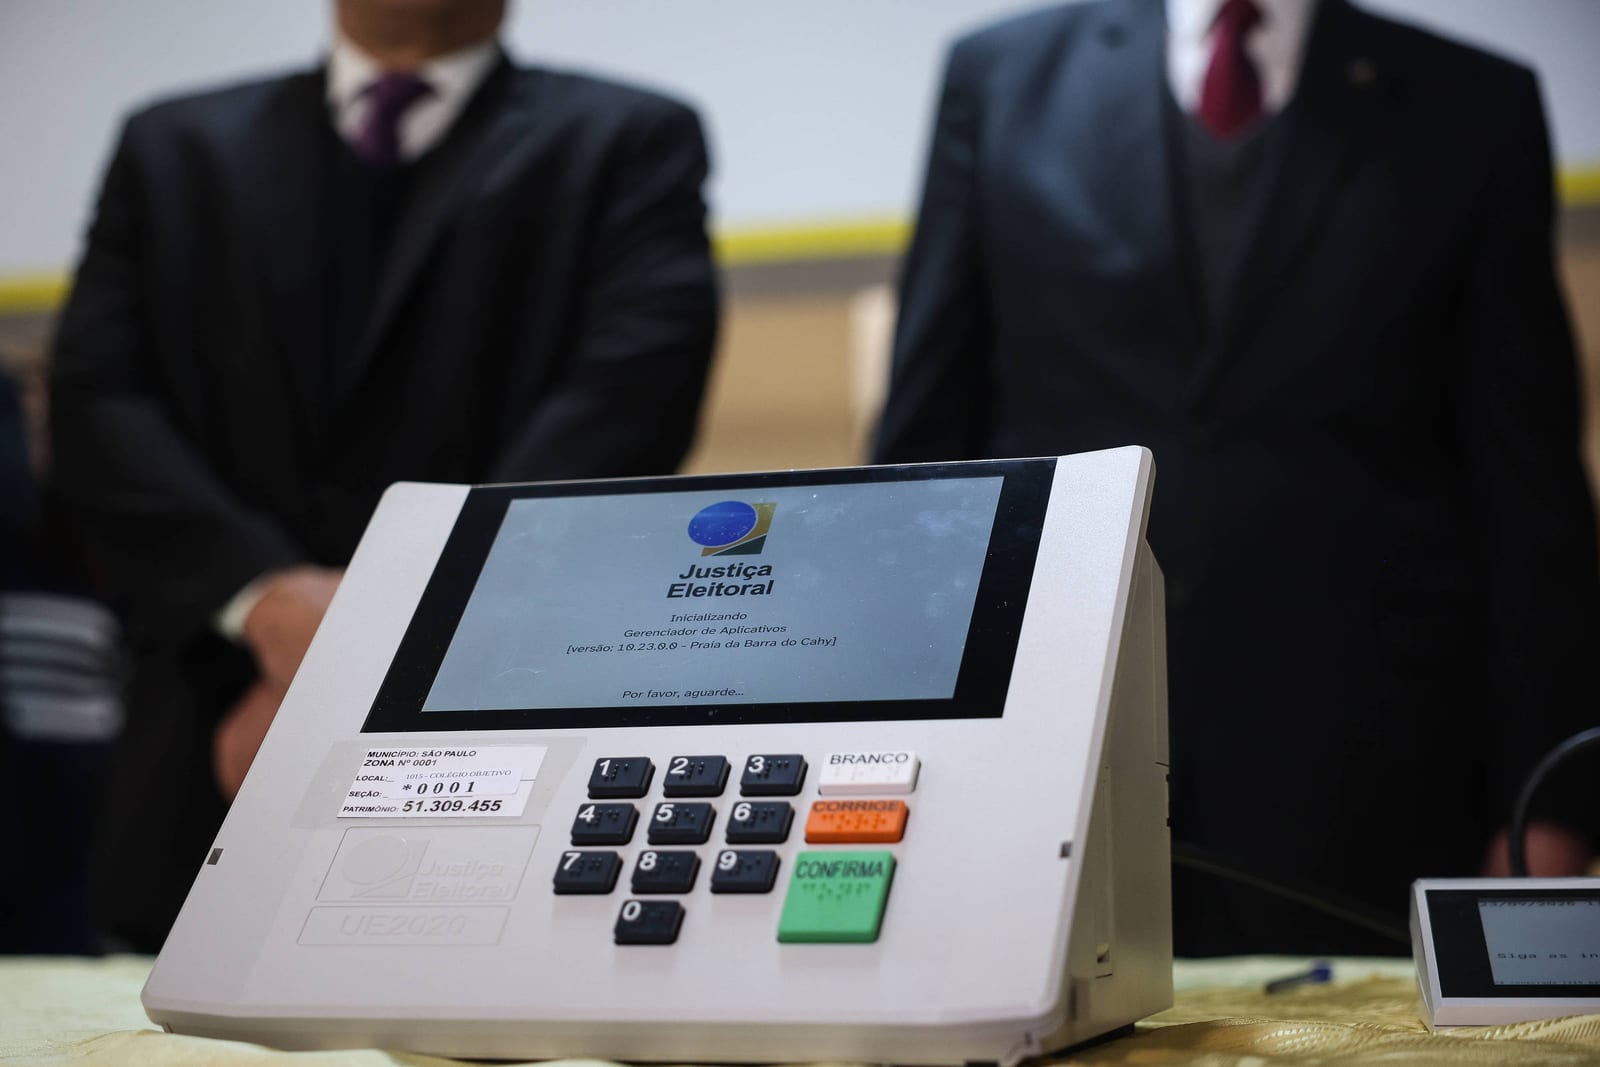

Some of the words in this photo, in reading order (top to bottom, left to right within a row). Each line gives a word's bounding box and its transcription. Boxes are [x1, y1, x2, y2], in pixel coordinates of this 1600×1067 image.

[679, 563, 773, 581] Justiça
[666, 580, 774, 598] Eleitoral
[670, 612, 748, 623] Inicializando
[623, 629, 699, 638] Gerenciador
[701, 628, 716, 636] de
[720, 625, 787, 636] Aplicativos
[566, 645, 614, 655] [versão:
[617, 642, 678, 652] 10.23.0.0
[690, 641, 721, 650] Praia
[725, 641, 740, 649] da
[744, 639, 777, 648] Barra
[781, 638, 797, 647] do
[800, 636, 837, 648] Cahy]
[622, 690, 643, 699] Por
[647, 689, 680, 699] favor,
[684, 688, 745, 699] aguarde...
[366, 750, 420, 758] MUNICÍPIO:
[421, 749, 442, 758] SÃO
[829, 754, 908, 765] BRANCO
[364, 759, 394, 767] ZONA
[412, 759, 437, 767] 0001
[600, 760, 611, 776] 1
[670, 757, 688, 775] 2
[748, 756, 764, 773] 3
[430, 771, 468, 780] COLÉGIO
[469, 769, 512, 778] OBJETIVO
[342, 805, 399, 813] PATRIMÔNIO:
[402, 800, 503, 813] 51.309.455
[578, 806, 596, 822] 4
[656, 804, 673, 821] 5
[734, 803, 752, 821] 6
[812, 802, 899, 813] CORRIGE
[563, 852, 581, 870] 7
[639, 852, 658, 870] 8
[719, 852, 737, 870] 9
[796, 860, 883, 879] CONFIRMA
[418, 860, 505, 880] Justiça
[411, 881, 511, 899] Eleitoral
[622, 901, 641, 920] 0
[338, 915, 468, 937] UE2020
